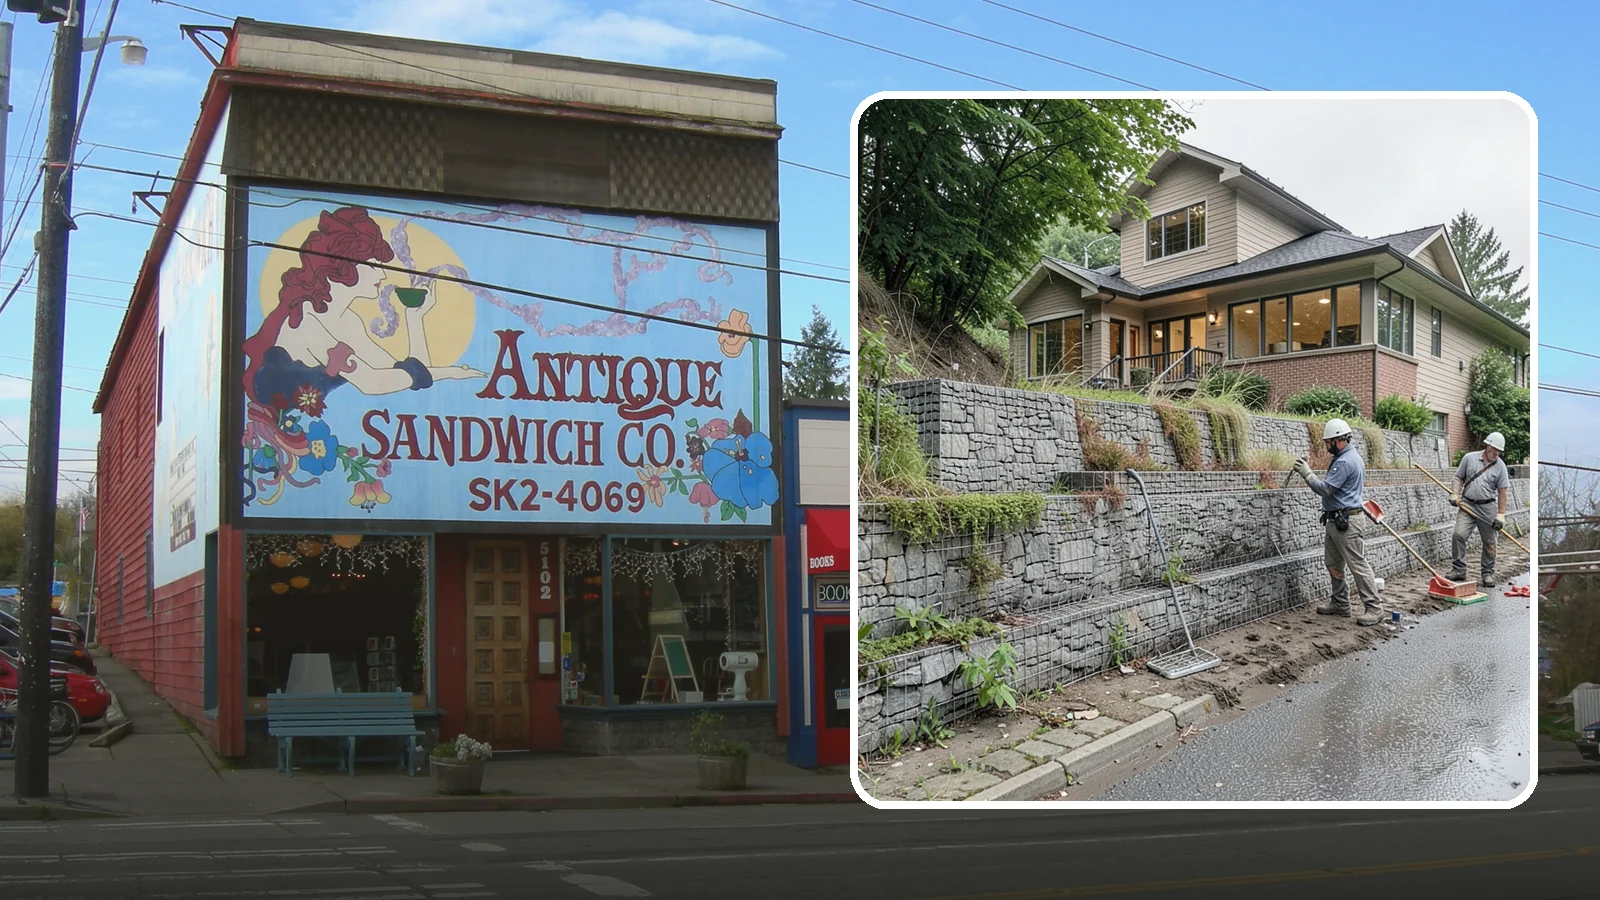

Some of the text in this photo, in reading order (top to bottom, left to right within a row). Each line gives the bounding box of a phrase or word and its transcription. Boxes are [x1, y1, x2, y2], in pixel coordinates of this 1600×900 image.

[475, 328, 724, 422] ANTIQUE
[361, 408, 686, 470] SANDWICH CO.
[468, 476, 647, 514] SK2-4069
[539, 541, 552, 600] 5102
[809, 555, 835, 569] BOOKS
